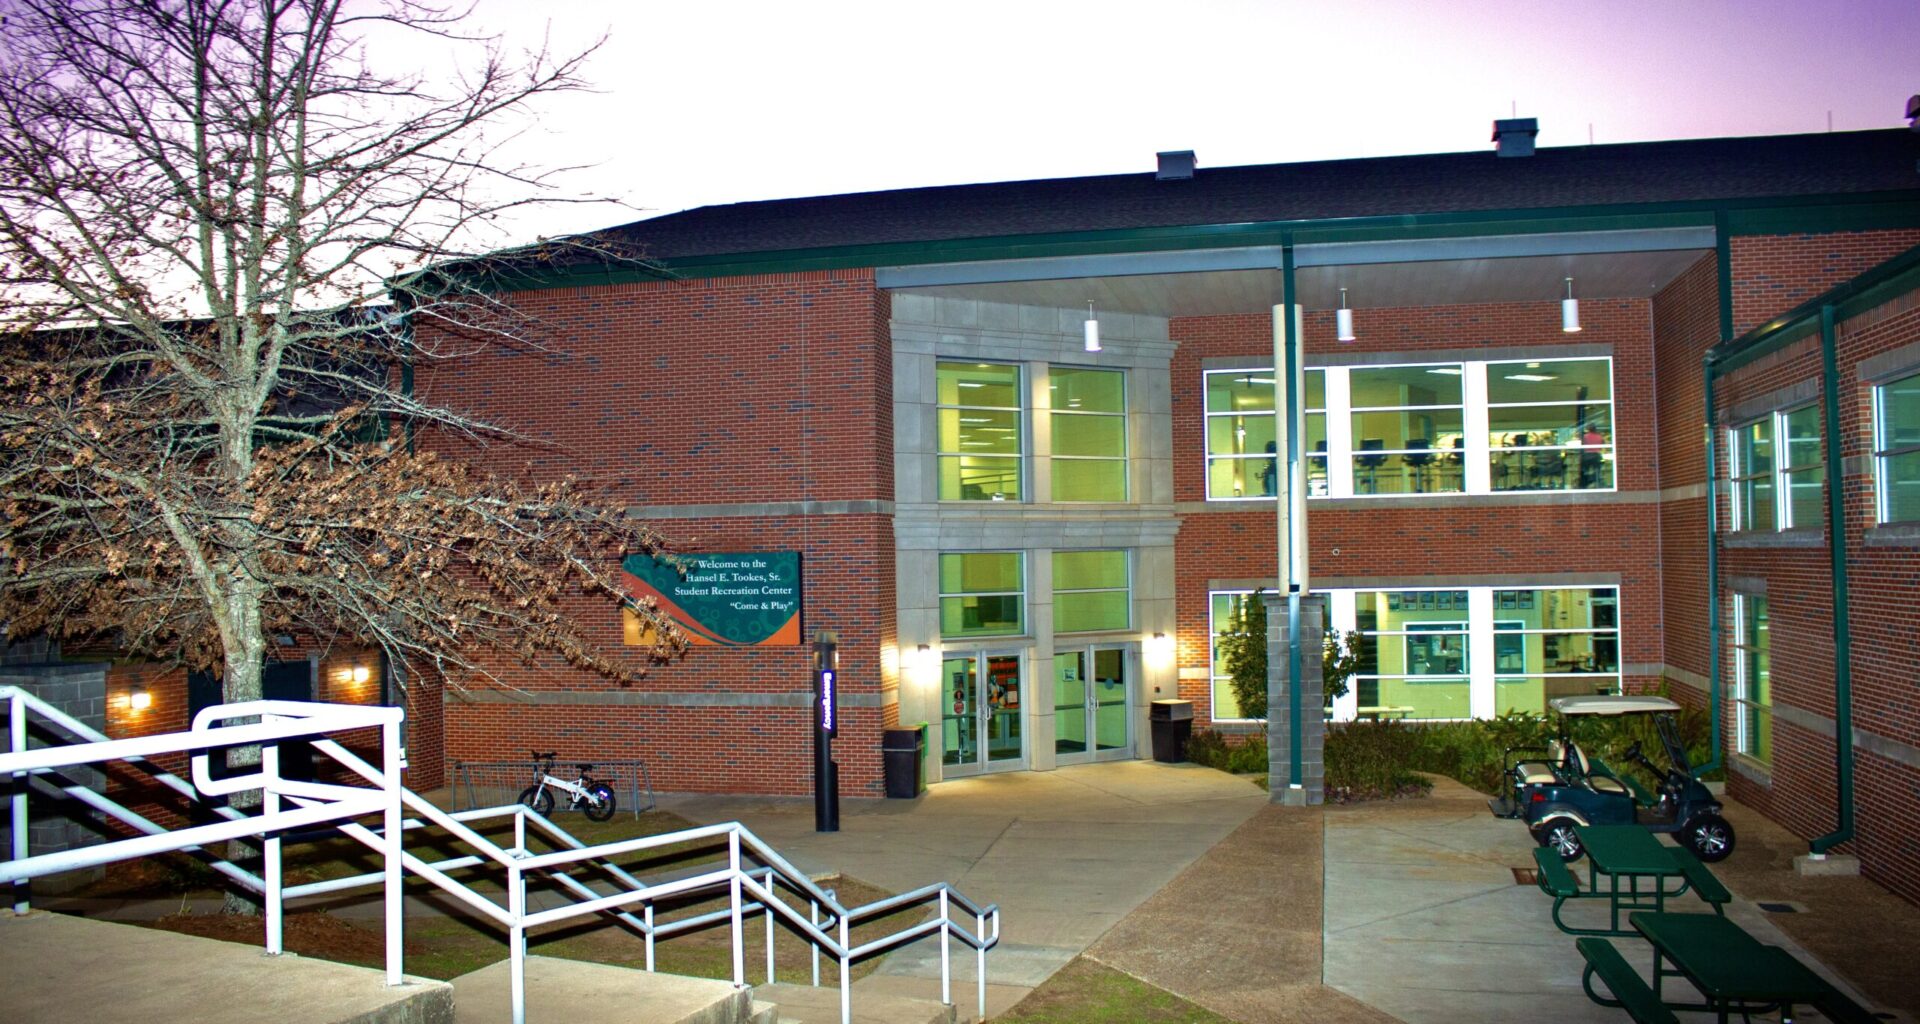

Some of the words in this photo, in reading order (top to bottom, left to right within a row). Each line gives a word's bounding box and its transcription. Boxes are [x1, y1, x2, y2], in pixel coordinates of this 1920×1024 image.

[698, 559, 739, 569] Welcome
[752, 559, 767, 568] the
[686, 573, 717, 582] Hansel
[719, 573, 730, 582] E.
[731, 572, 767, 583] Tookes,
[768, 571, 781, 581] Sr.
[674, 586, 709, 596] Student
[711, 586, 760, 596] Recreation
[761, 585, 792, 595] Center
[760, 602, 769, 610] &
